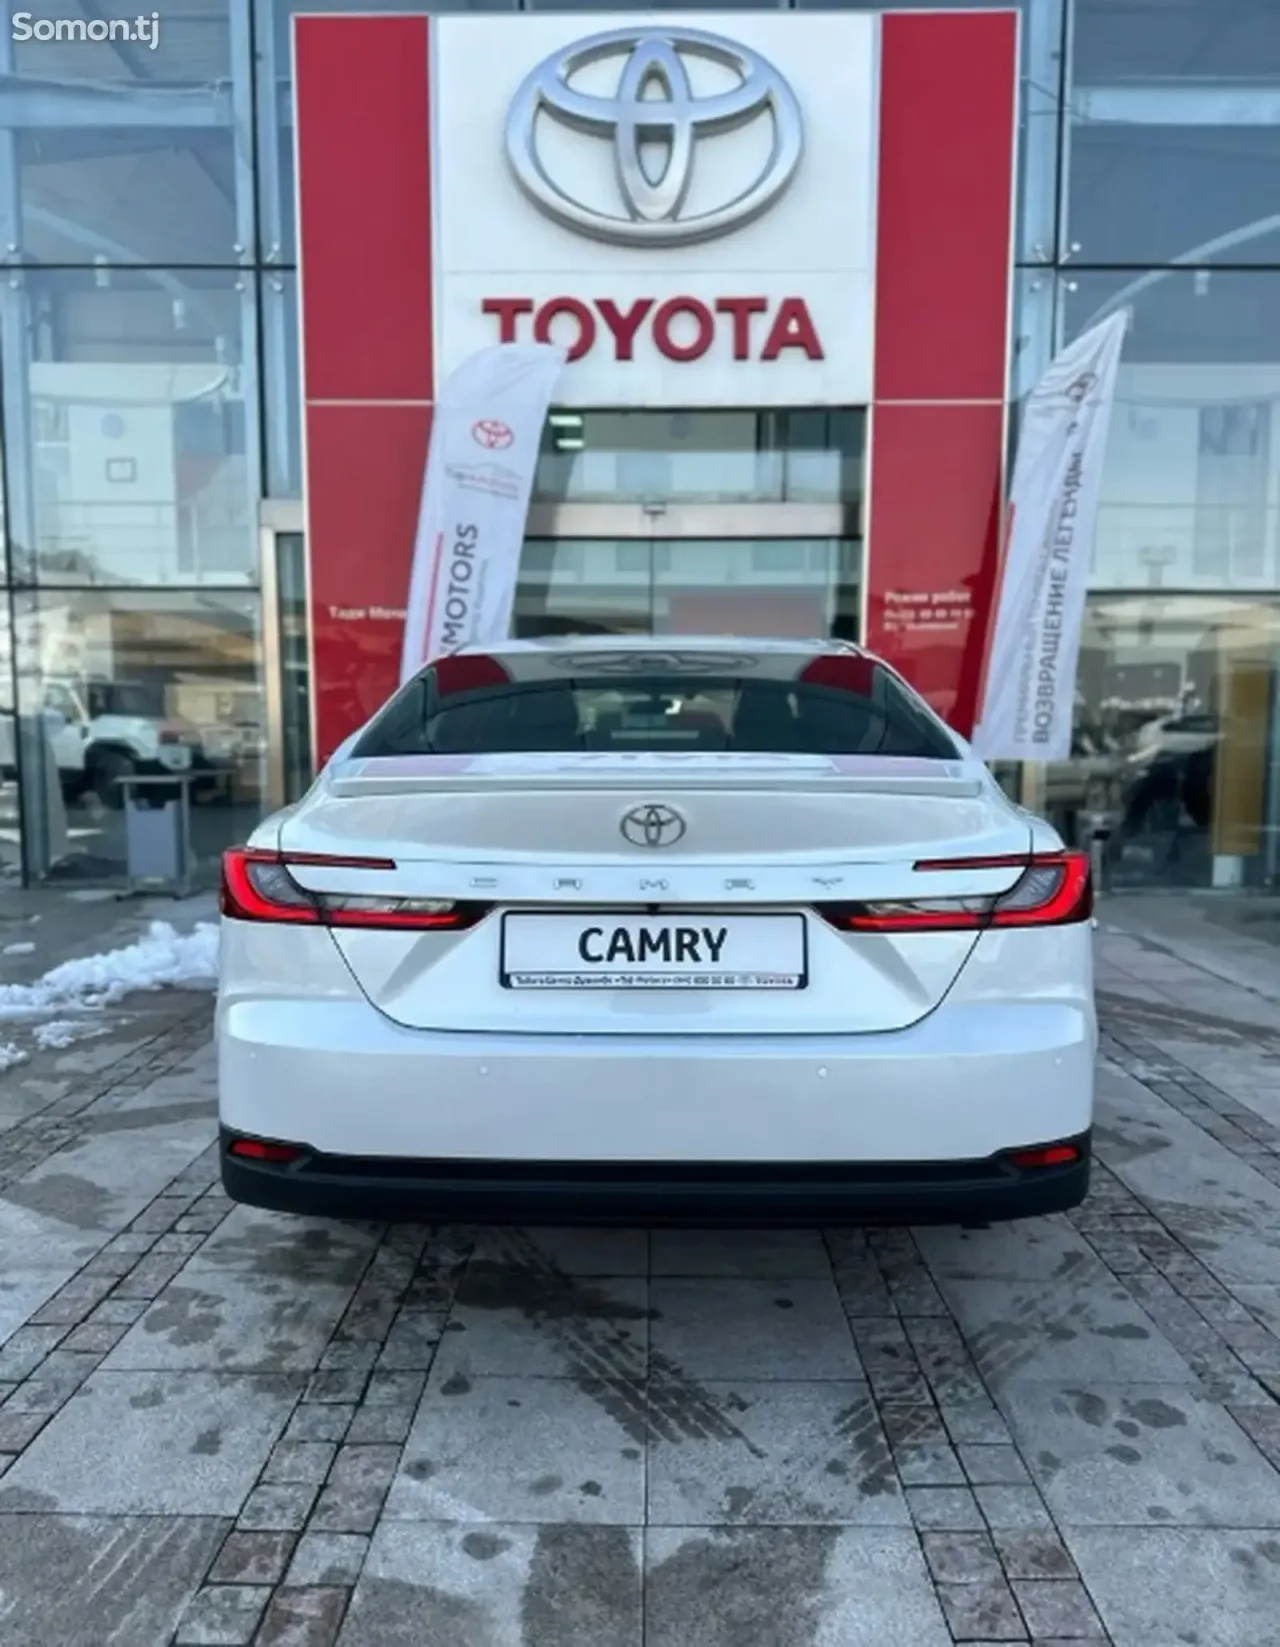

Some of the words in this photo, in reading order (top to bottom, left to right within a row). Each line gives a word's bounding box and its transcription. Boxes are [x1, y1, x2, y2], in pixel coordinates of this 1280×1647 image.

[481, 296, 825, 362] TOYOTA
[440, 523, 478, 645] MOTORS
[1032, 566, 1068, 743] ВОЗВРАЩЕНИЕ
[578, 926, 728, 963] CAMRY
